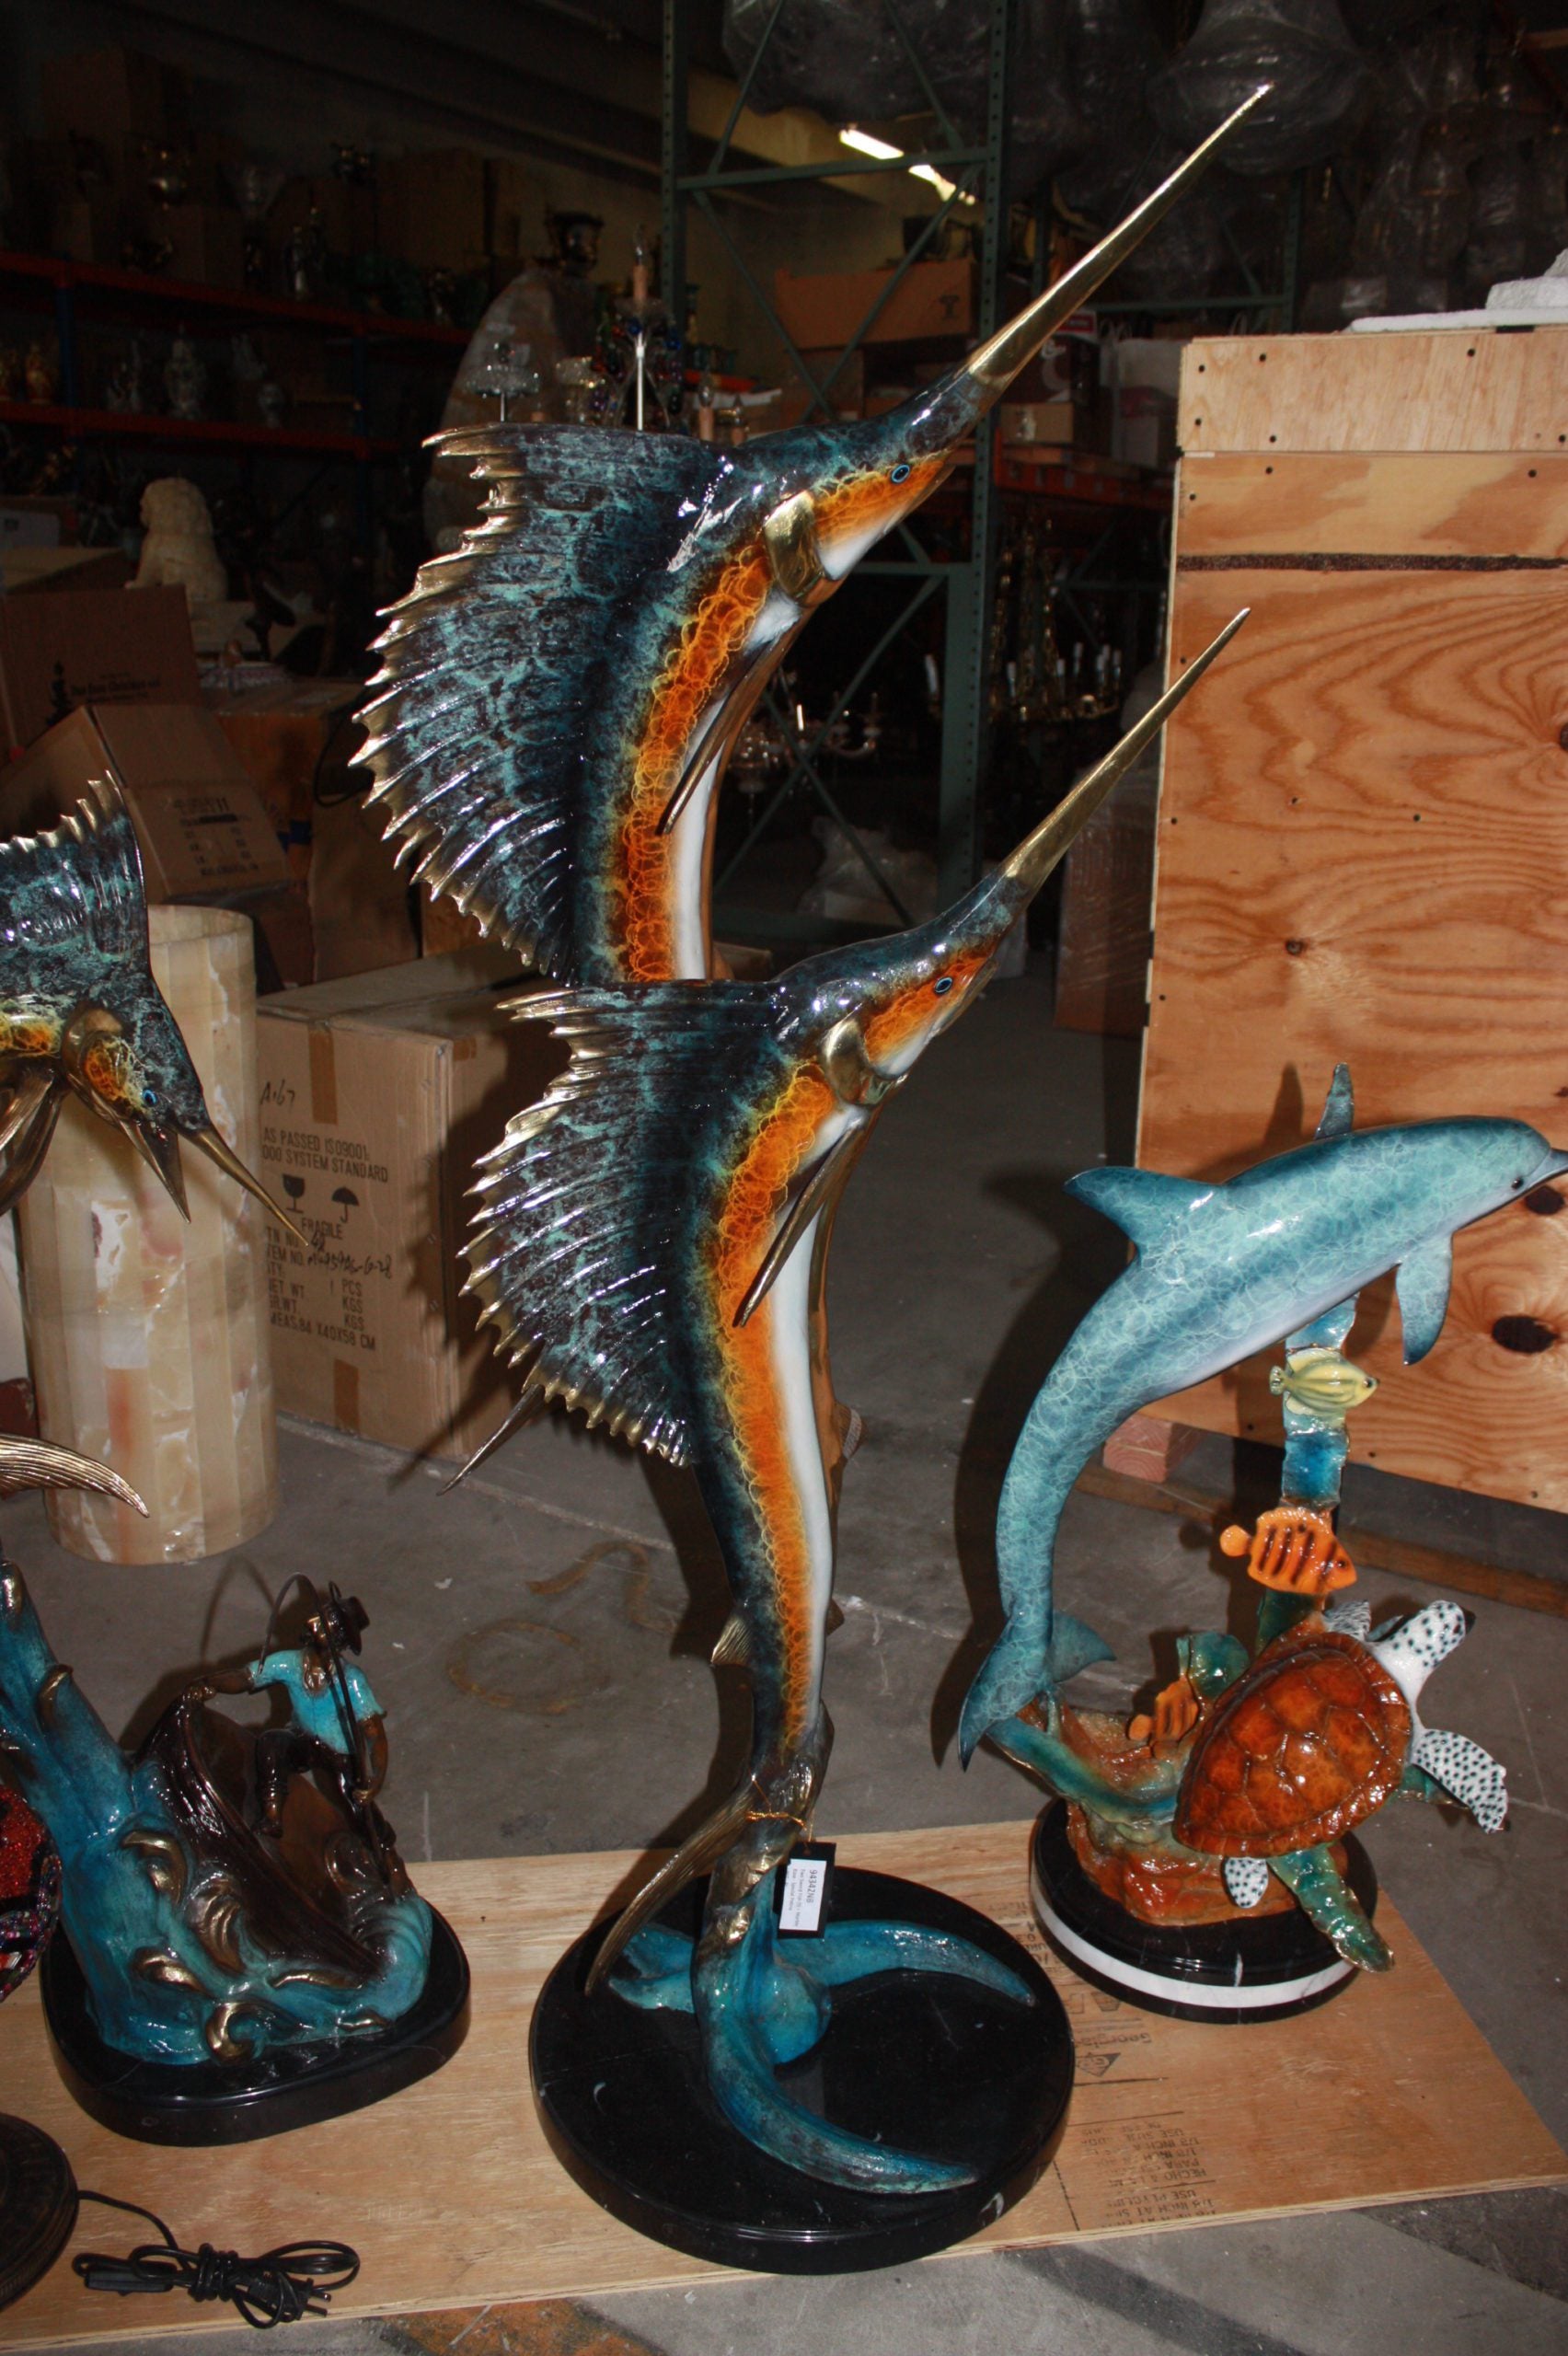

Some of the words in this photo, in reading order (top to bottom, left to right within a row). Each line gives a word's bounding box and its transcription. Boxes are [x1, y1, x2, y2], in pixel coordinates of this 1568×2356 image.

[281, 1129, 320, 1151] PASSED
[286, 1149, 329, 1171] SYSTEM
[332, 1158, 388, 1184] STANDARD
[301, 1218, 342, 1240] FRAGILE
[341, 1278, 362, 1297] PCS
[342, 1296, 363, 1313] KGS
[344, 1313, 364, 1332] KGS
[361, 1334, 375, 1350] CM
